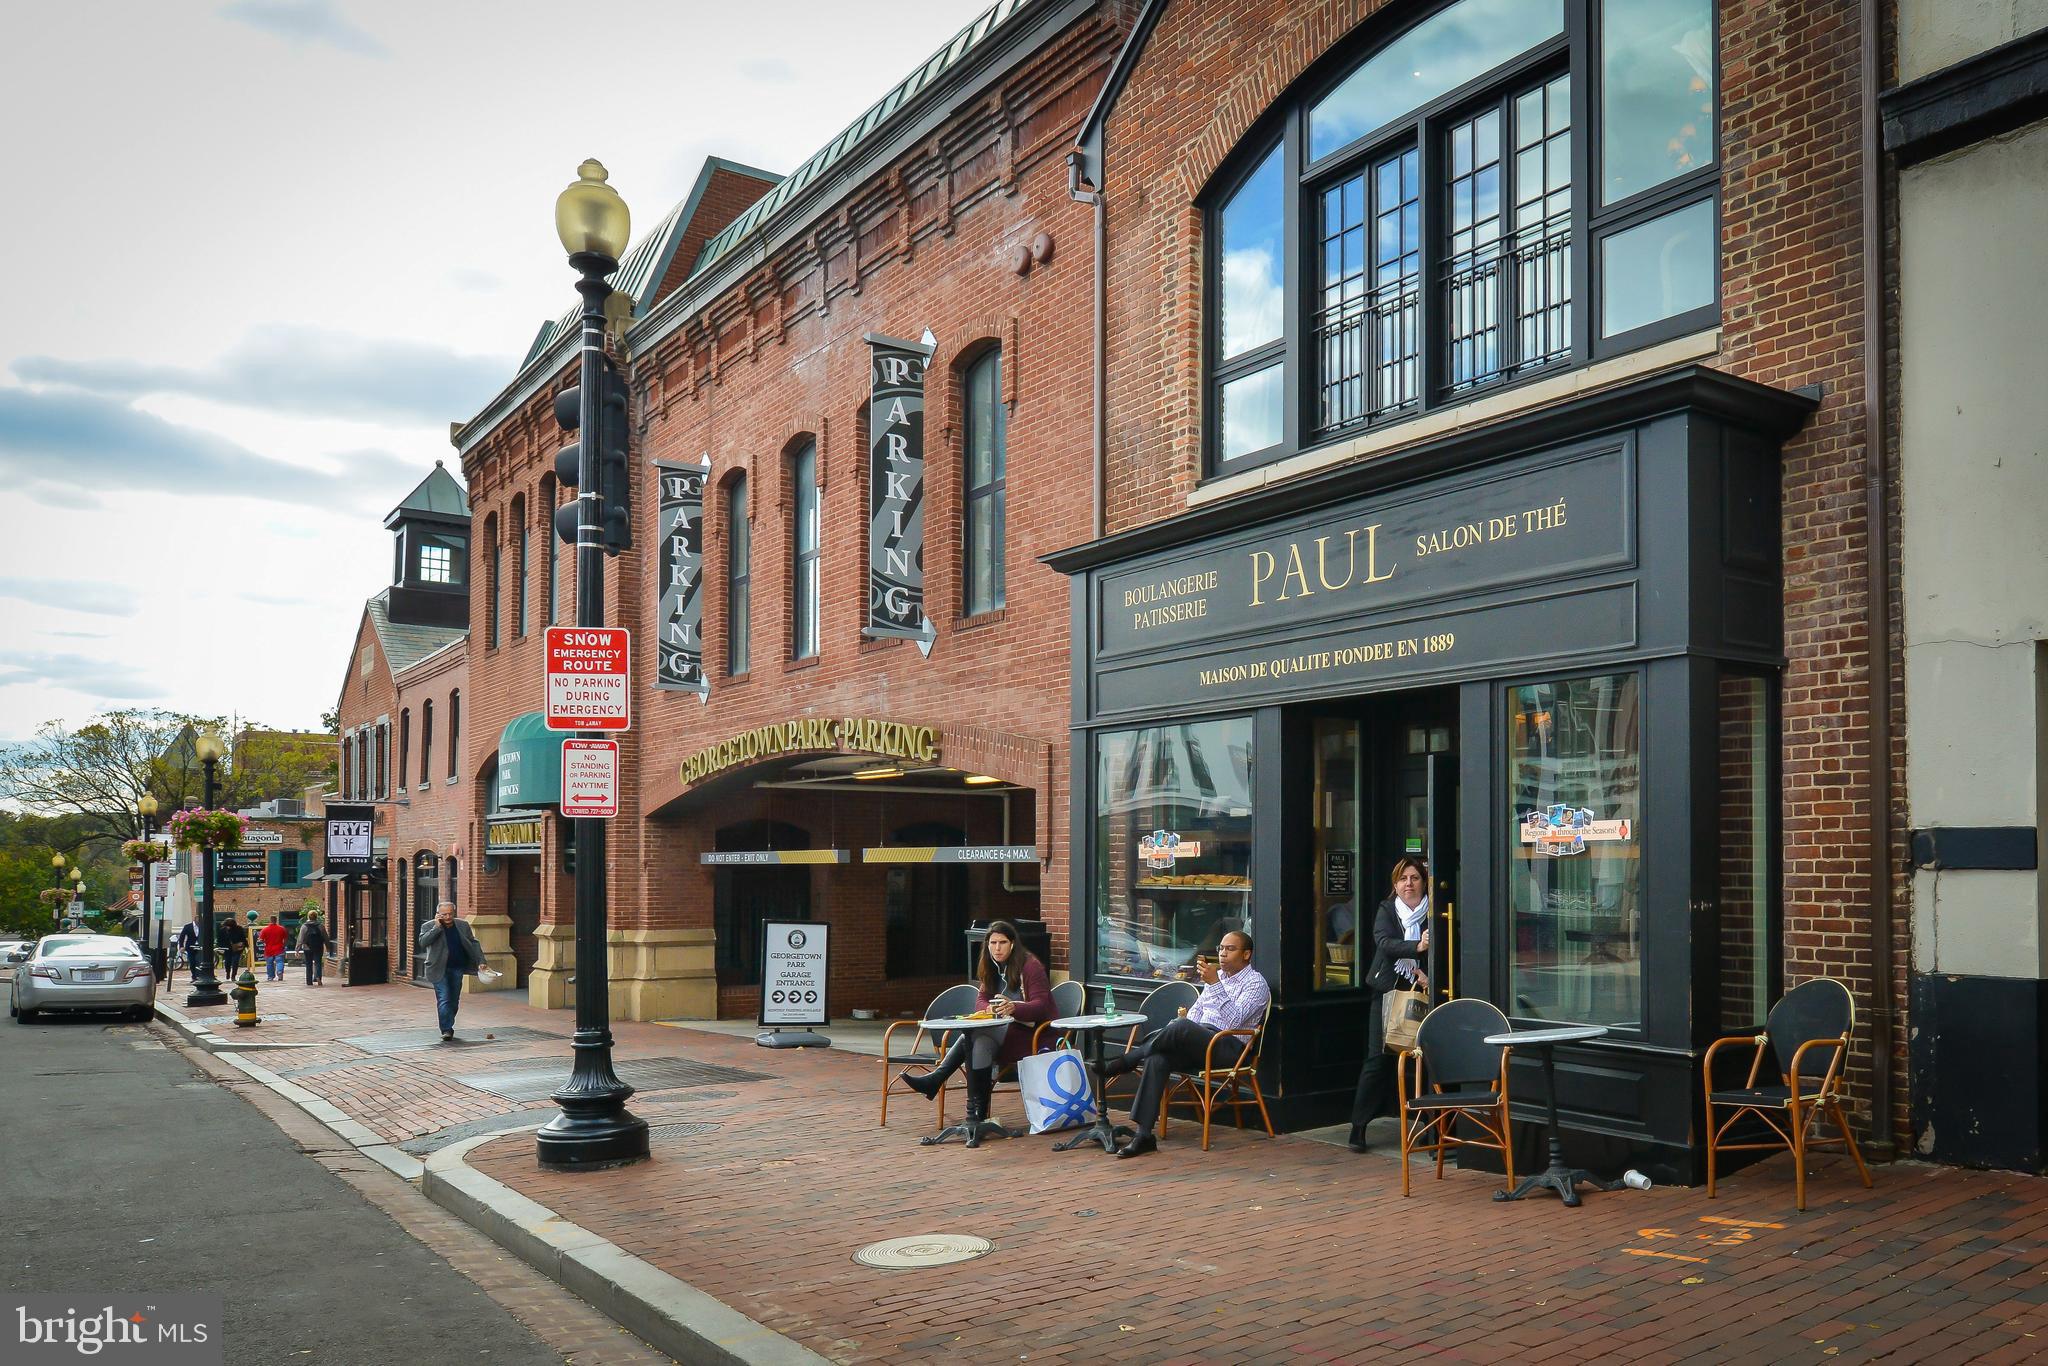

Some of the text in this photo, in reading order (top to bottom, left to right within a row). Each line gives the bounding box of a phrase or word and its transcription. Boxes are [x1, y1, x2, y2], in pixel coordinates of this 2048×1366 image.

[884, 356, 912, 616] PARKING
[1416, 496, 1568, 557] SALON DE THÉ
[1248, 523, 1398, 607] PAUL
[668, 477, 693, 675] PARKING
[1124, 570, 1219, 608] BOULANGERIE
[1133, 598, 1207, 630] PATISSERIE
[563, 633, 612, 646] SNOW
[553, 648, 621, 659] EMERGENCY
[1199, 632, 1455, 686] MAISON DE QUALITE FONDEE EN 1889
[563, 660, 613, 671] ROUTE
[554, 677, 621, 688] NO PARKING
[566, 691, 610, 701] DURING
[553, 704, 622, 715] EMERGENCY
[679, 717, 935, 786] GEORGETOWN PARK PARKING
[570, 762, 610, 770] STANDING
[580, 771, 611, 779] PARKING
[329, 822, 369, 836] FRYE
[1524, 828, 1547, 839] Regions
[1581, 826, 1592, 835] the
[1592, 825, 1617, 836] Seasons!
[708, 854, 715, 862] DO
[716, 854, 725, 862] NOT
[725, 854, 741, 862] ENTER
[744, 853, 755, 862] EXIT
[755, 853, 769, 862] ONLY
[957, 849, 998, 860] CLEARANCE
[1013, 848, 1031, 860] MAX.
[770, 952, 822, 960] GEORGETOWN
